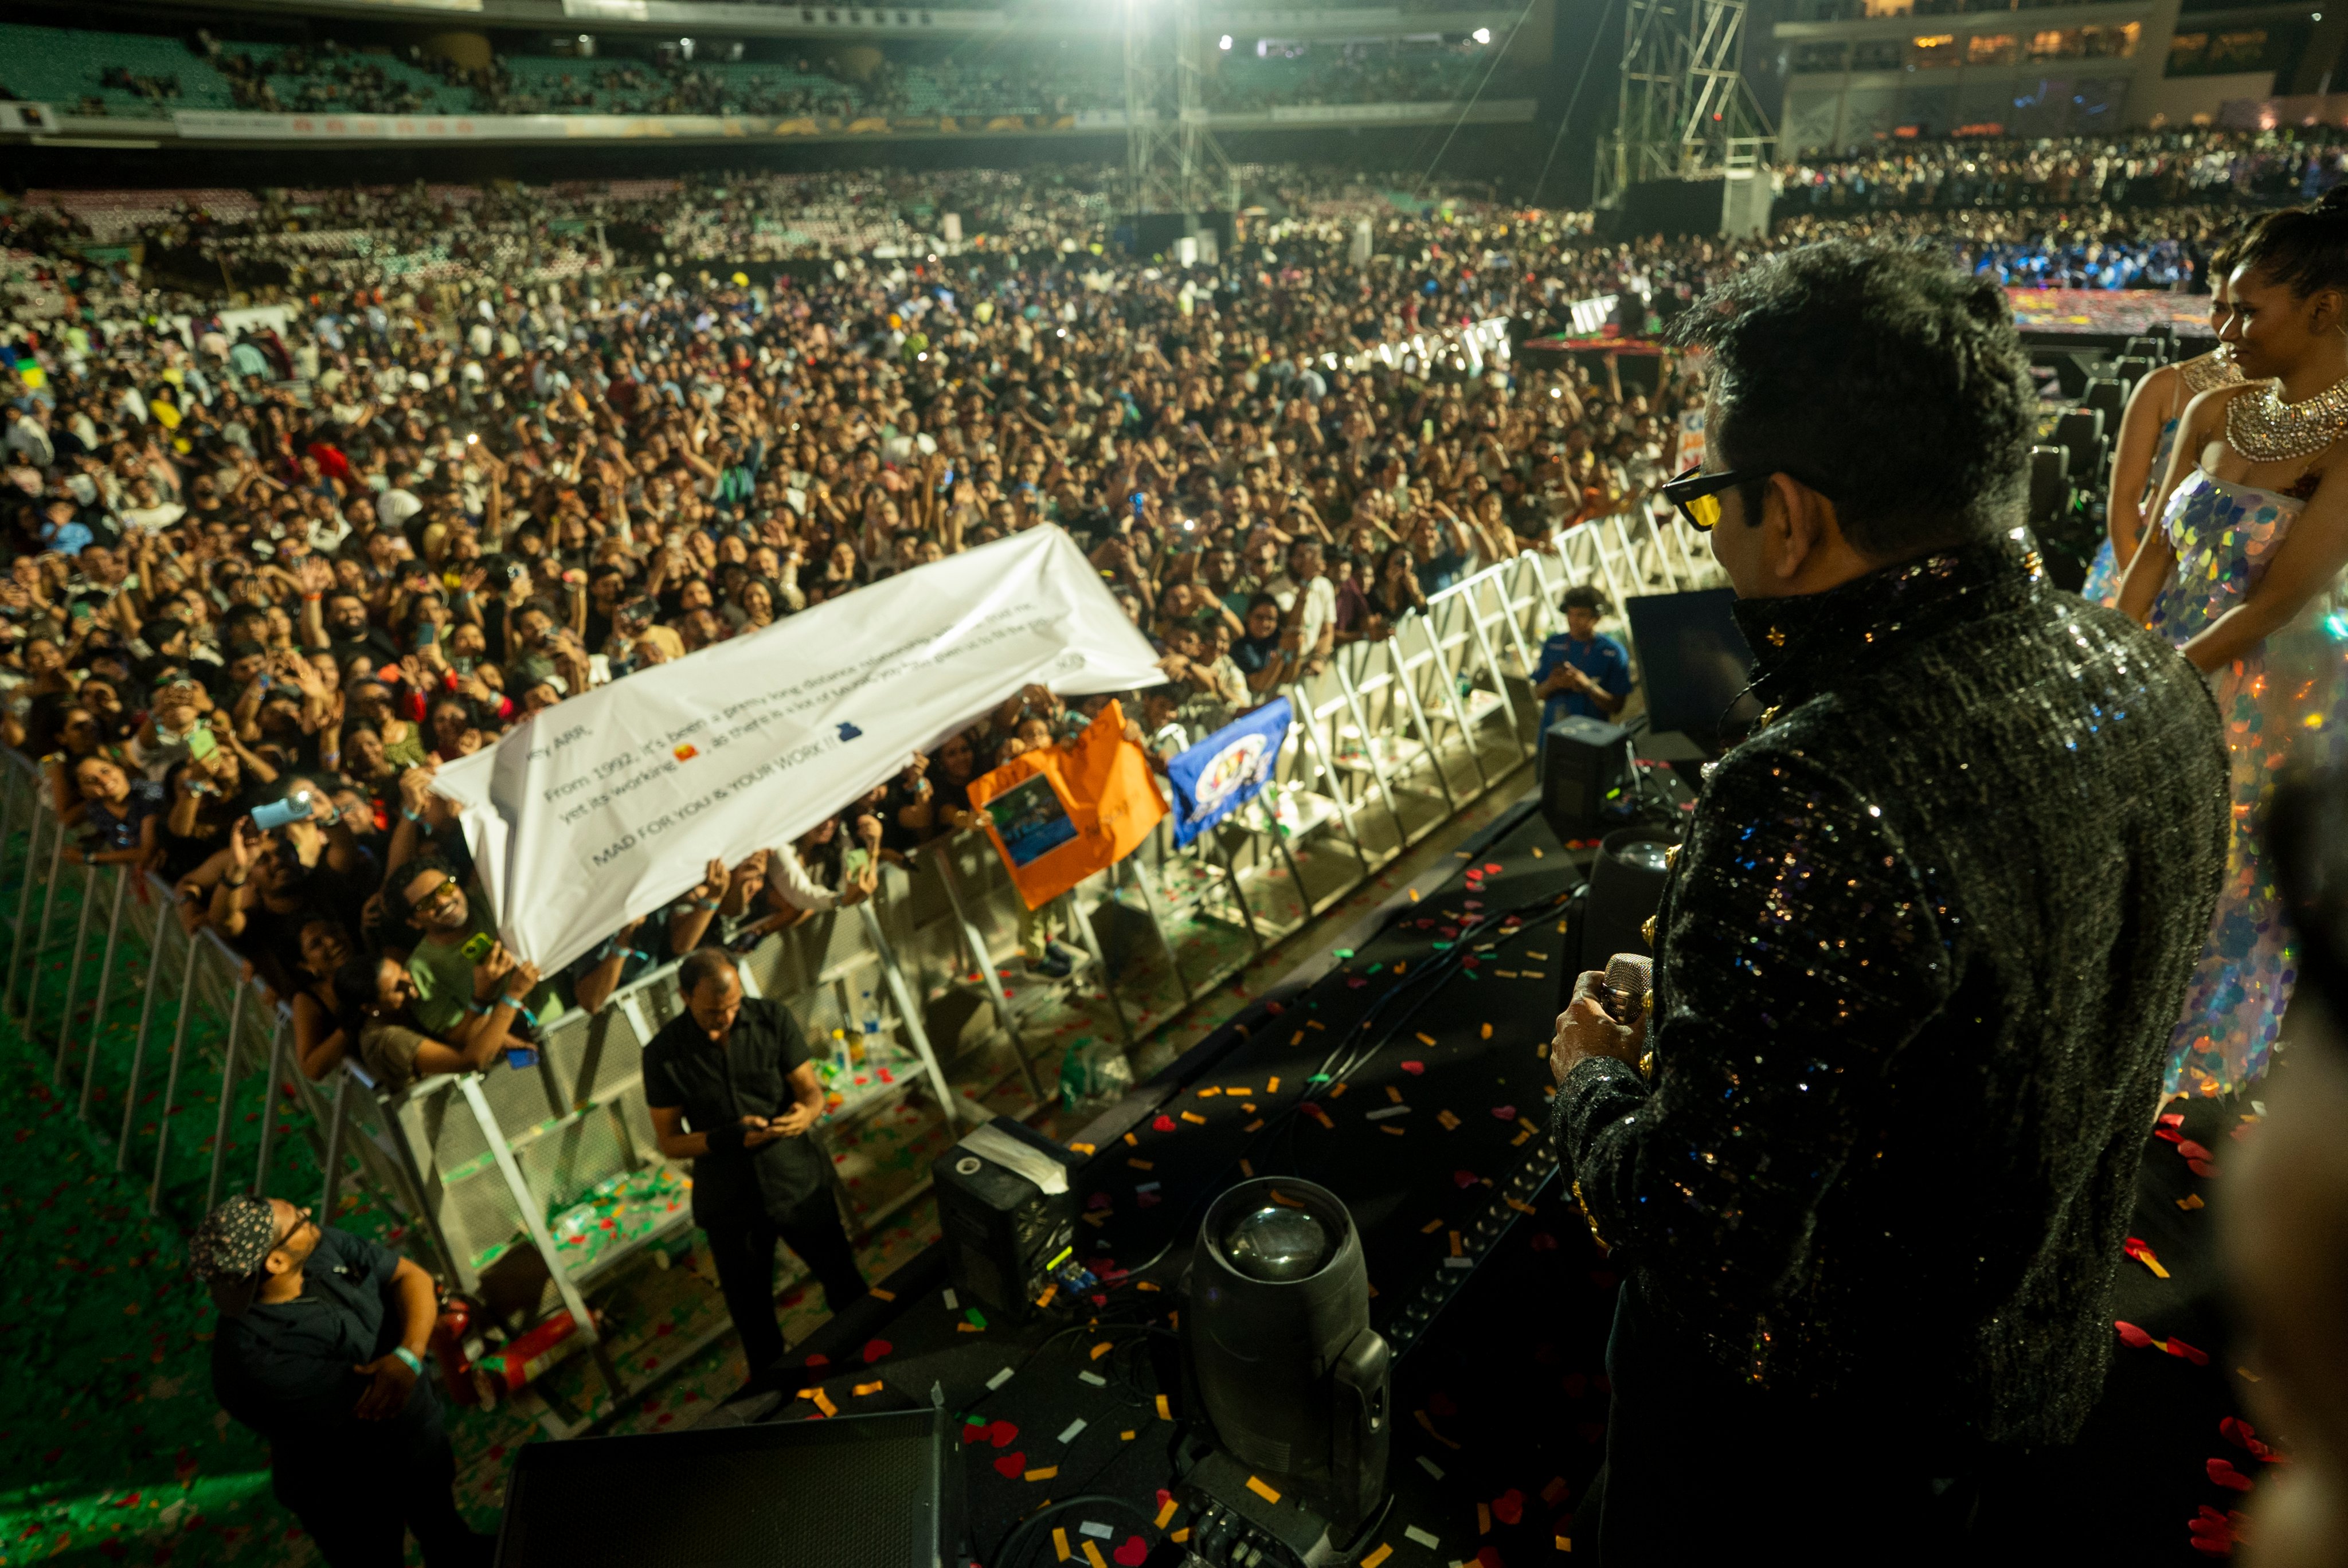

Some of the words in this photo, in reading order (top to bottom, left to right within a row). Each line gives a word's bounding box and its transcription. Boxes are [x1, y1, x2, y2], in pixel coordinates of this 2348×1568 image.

[543, 775, 590, 802] From
[665, 718, 707, 743] been
[711, 714, 721, 723] a
[723, 696, 766, 719] pretty
[770, 686, 801, 700] long
[803, 666, 856, 689] distance
[559, 804, 587, 825] yet
[589, 794, 610, 807] its
[611, 759, 677, 795] working
[711, 734, 729, 747] as
[729, 715, 769, 739] there
[770, 709, 784, 719] is
[786, 706, 795, 715] a
[796, 698, 816, 711] lot
[816, 692, 831, 704] of
[593, 834, 636, 866] MAD
[638, 815, 676, 839] FOR
[672, 795, 711, 820] YOU
[713, 788, 729, 801] &
[729, 763, 773, 791] YOUR
[774, 742, 822, 770] WORK
